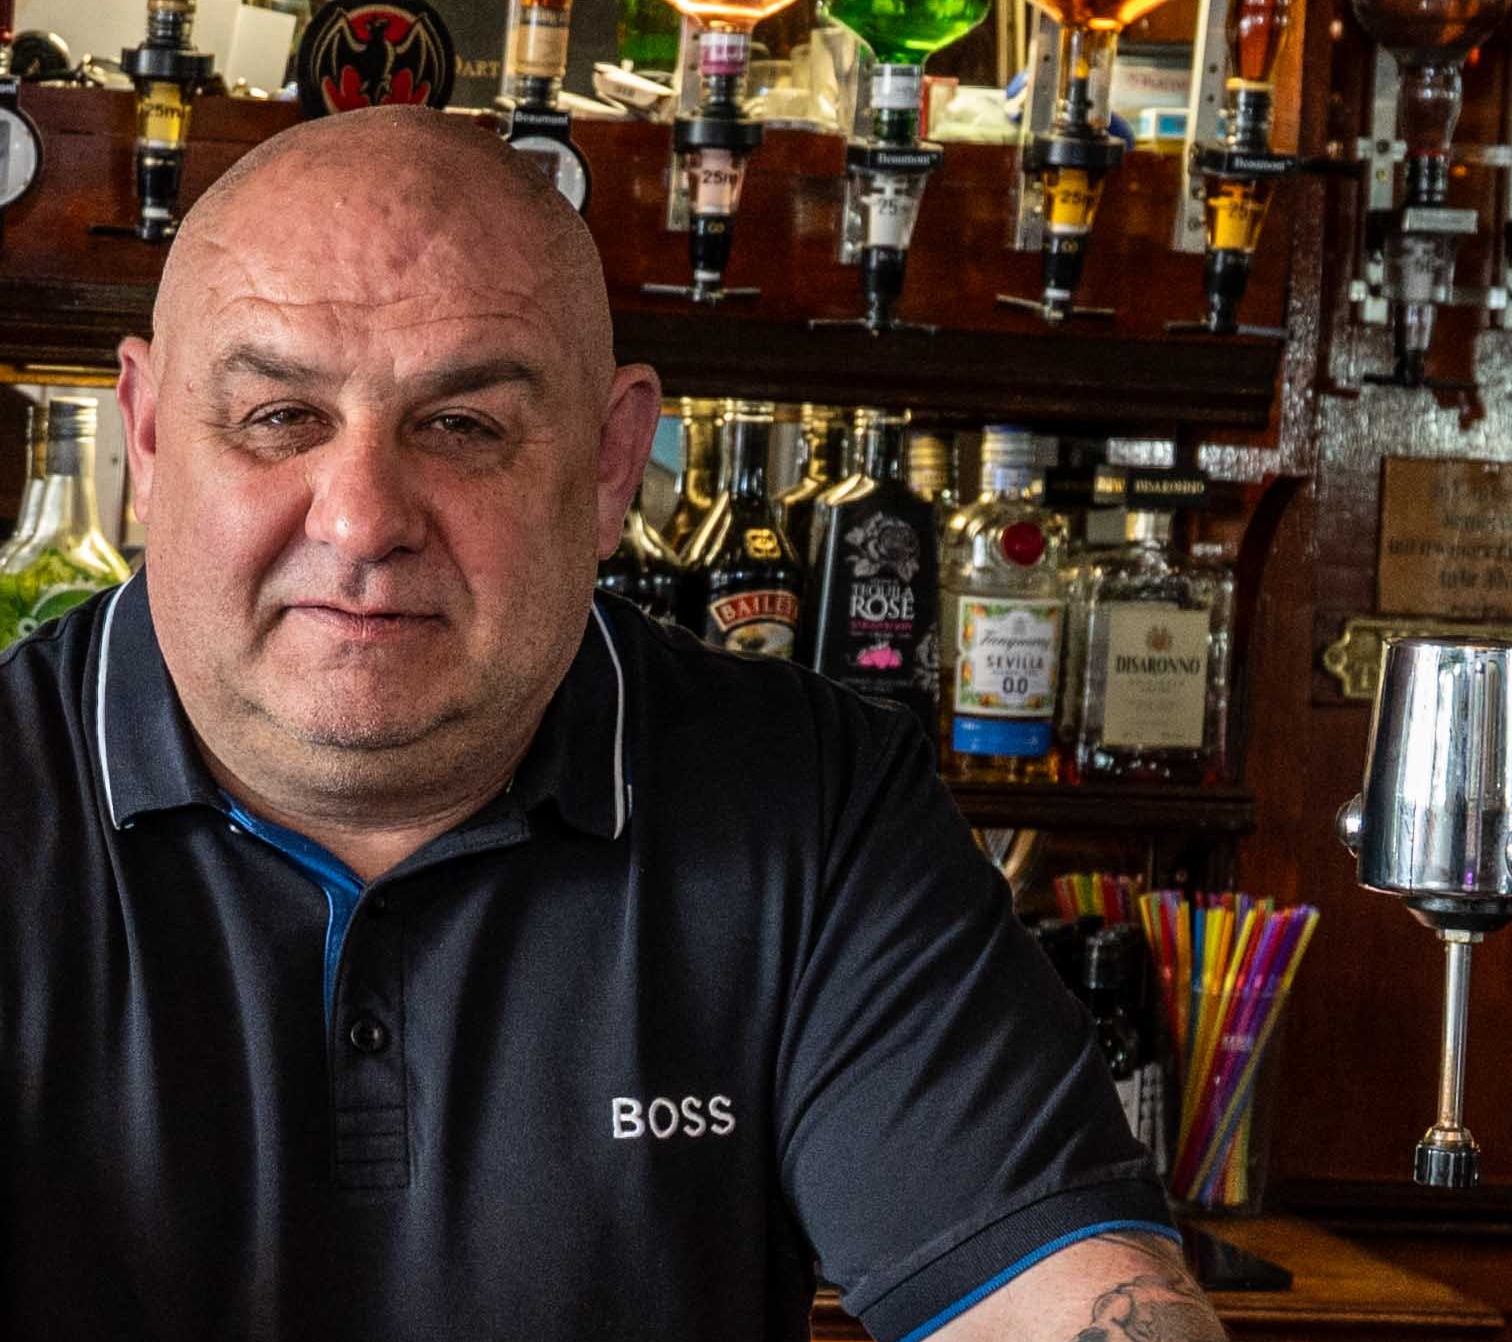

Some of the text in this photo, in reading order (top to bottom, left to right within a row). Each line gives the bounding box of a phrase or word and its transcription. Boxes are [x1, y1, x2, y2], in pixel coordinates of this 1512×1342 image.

[515, 111, 568, 125] Beaumont
[878, 153, 931, 166] Beaumont
[1235, 157, 1287, 170] Beaumont
[1134, 478, 1204, 494] DISARONNO
[851, 584, 912, 602] TEQUILA
[850, 596, 915, 620] ROSE
[986, 655, 1043, 670] SEVILLA
[1116, 655, 1200, 676] DISARONNO
[1002, 677, 1029, 696] 0.0
[612, 1095, 736, 1139] BOSS
